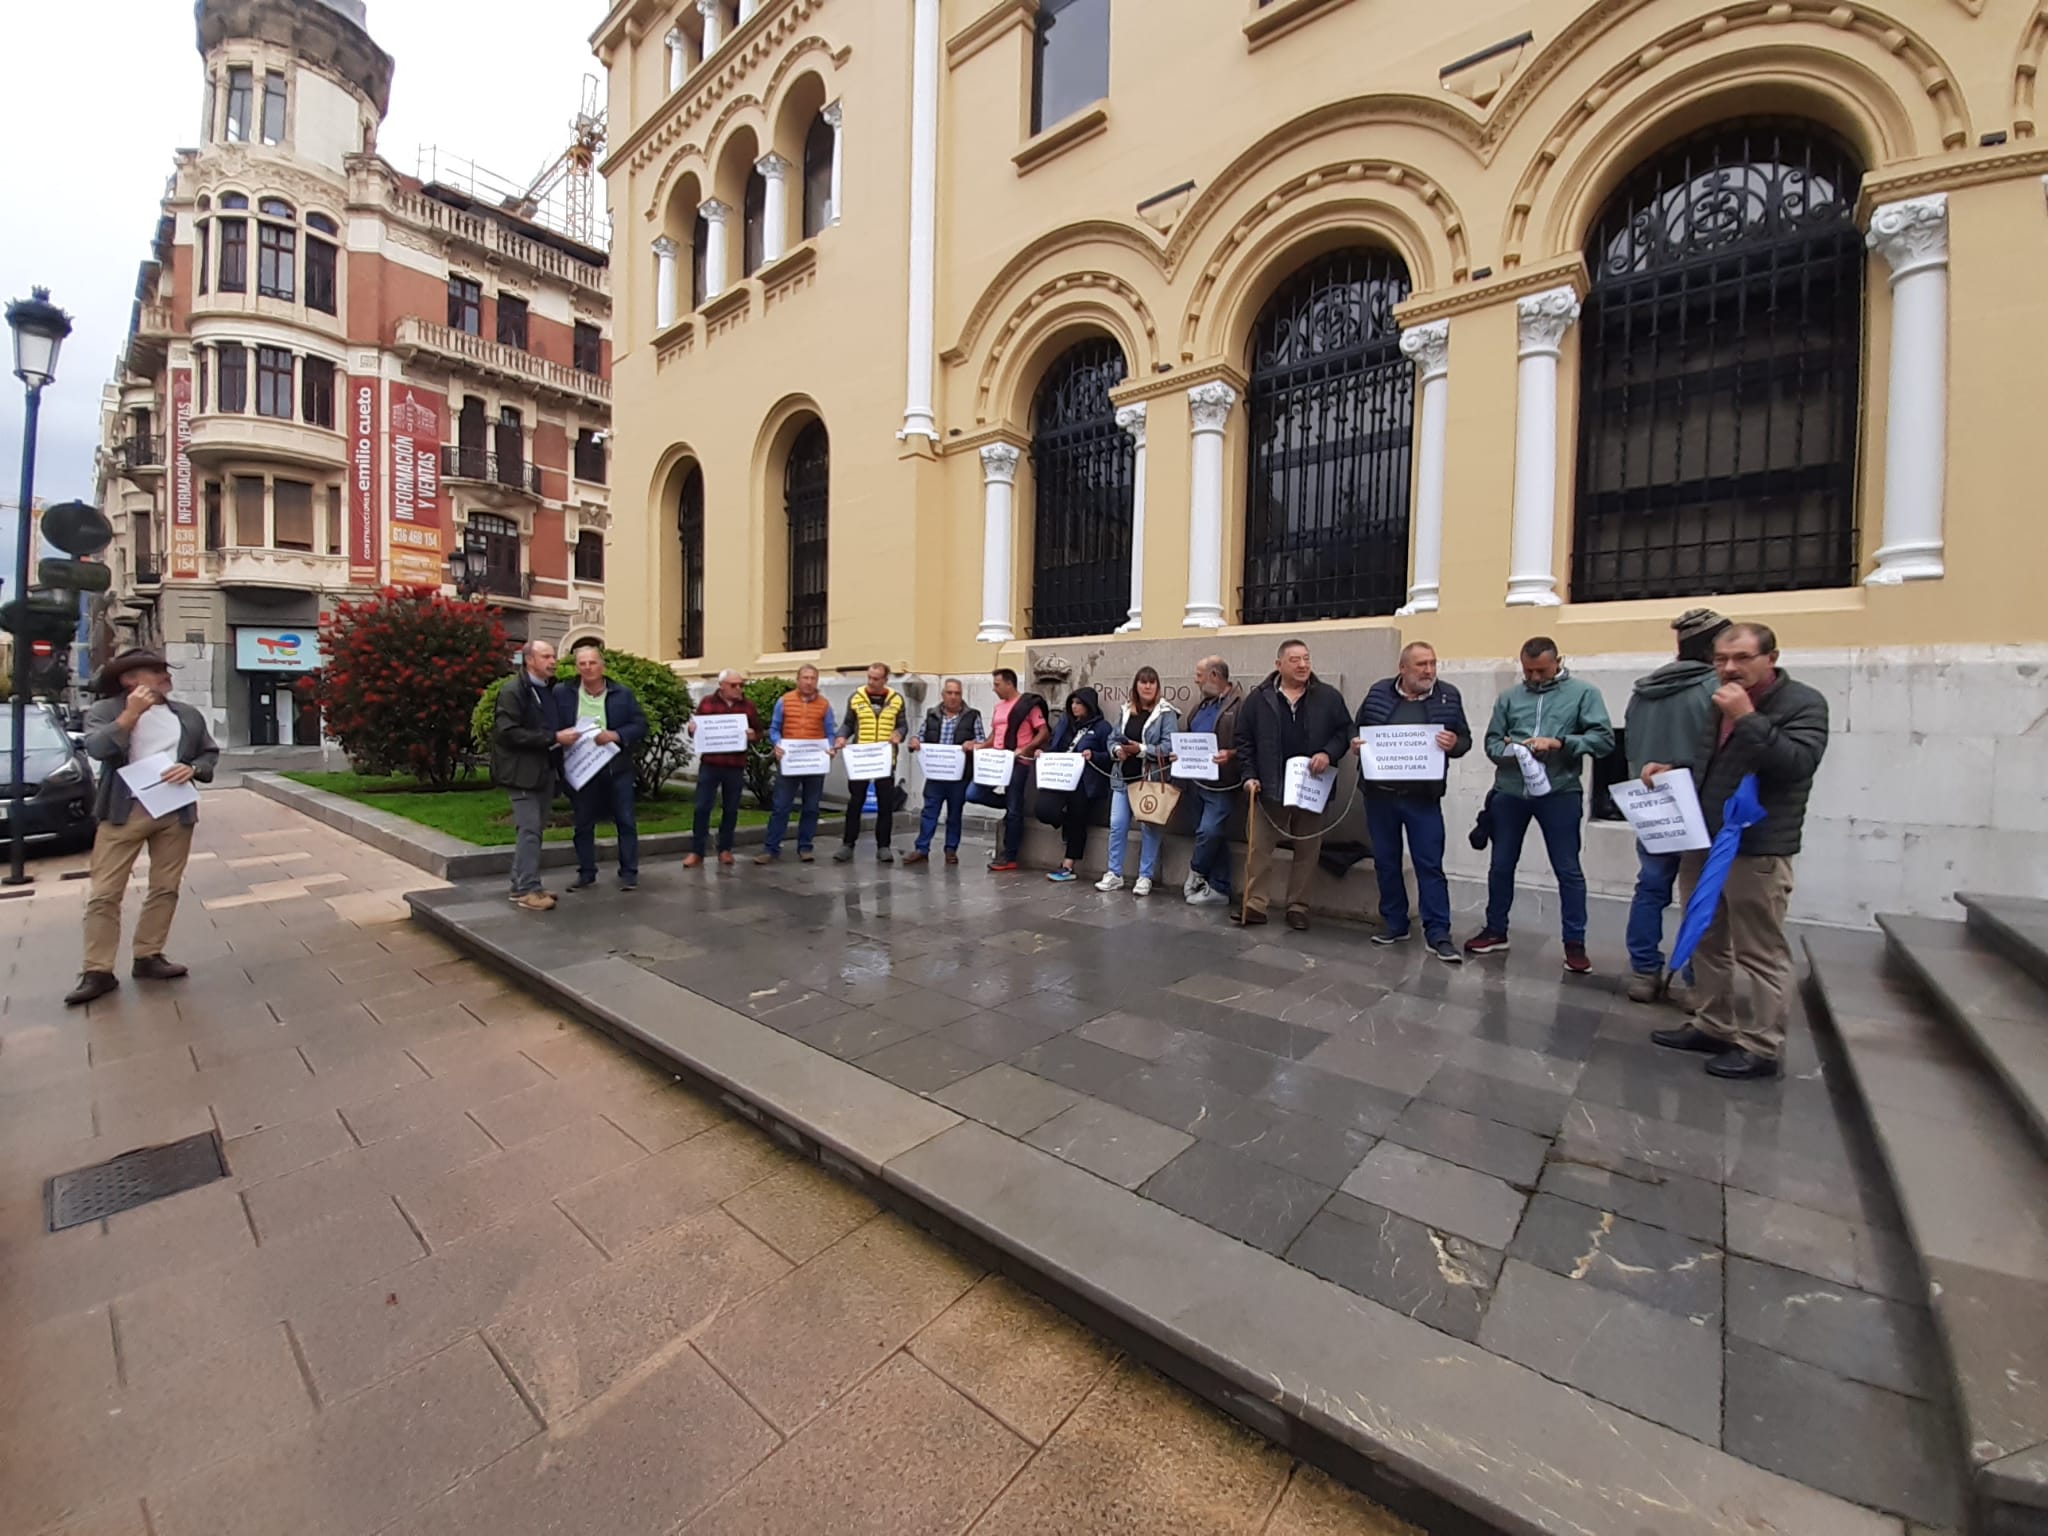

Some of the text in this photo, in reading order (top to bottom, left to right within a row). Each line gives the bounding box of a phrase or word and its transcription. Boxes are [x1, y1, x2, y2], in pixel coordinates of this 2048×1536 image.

[357, 387, 372, 435] cueto
[355, 439, 371, 491] emilio
[392, 435, 414, 520] INFORMACIÓN
[418, 451, 436, 508] Y VENTAS
[1093, 682, 1192, 702] PRINDO
